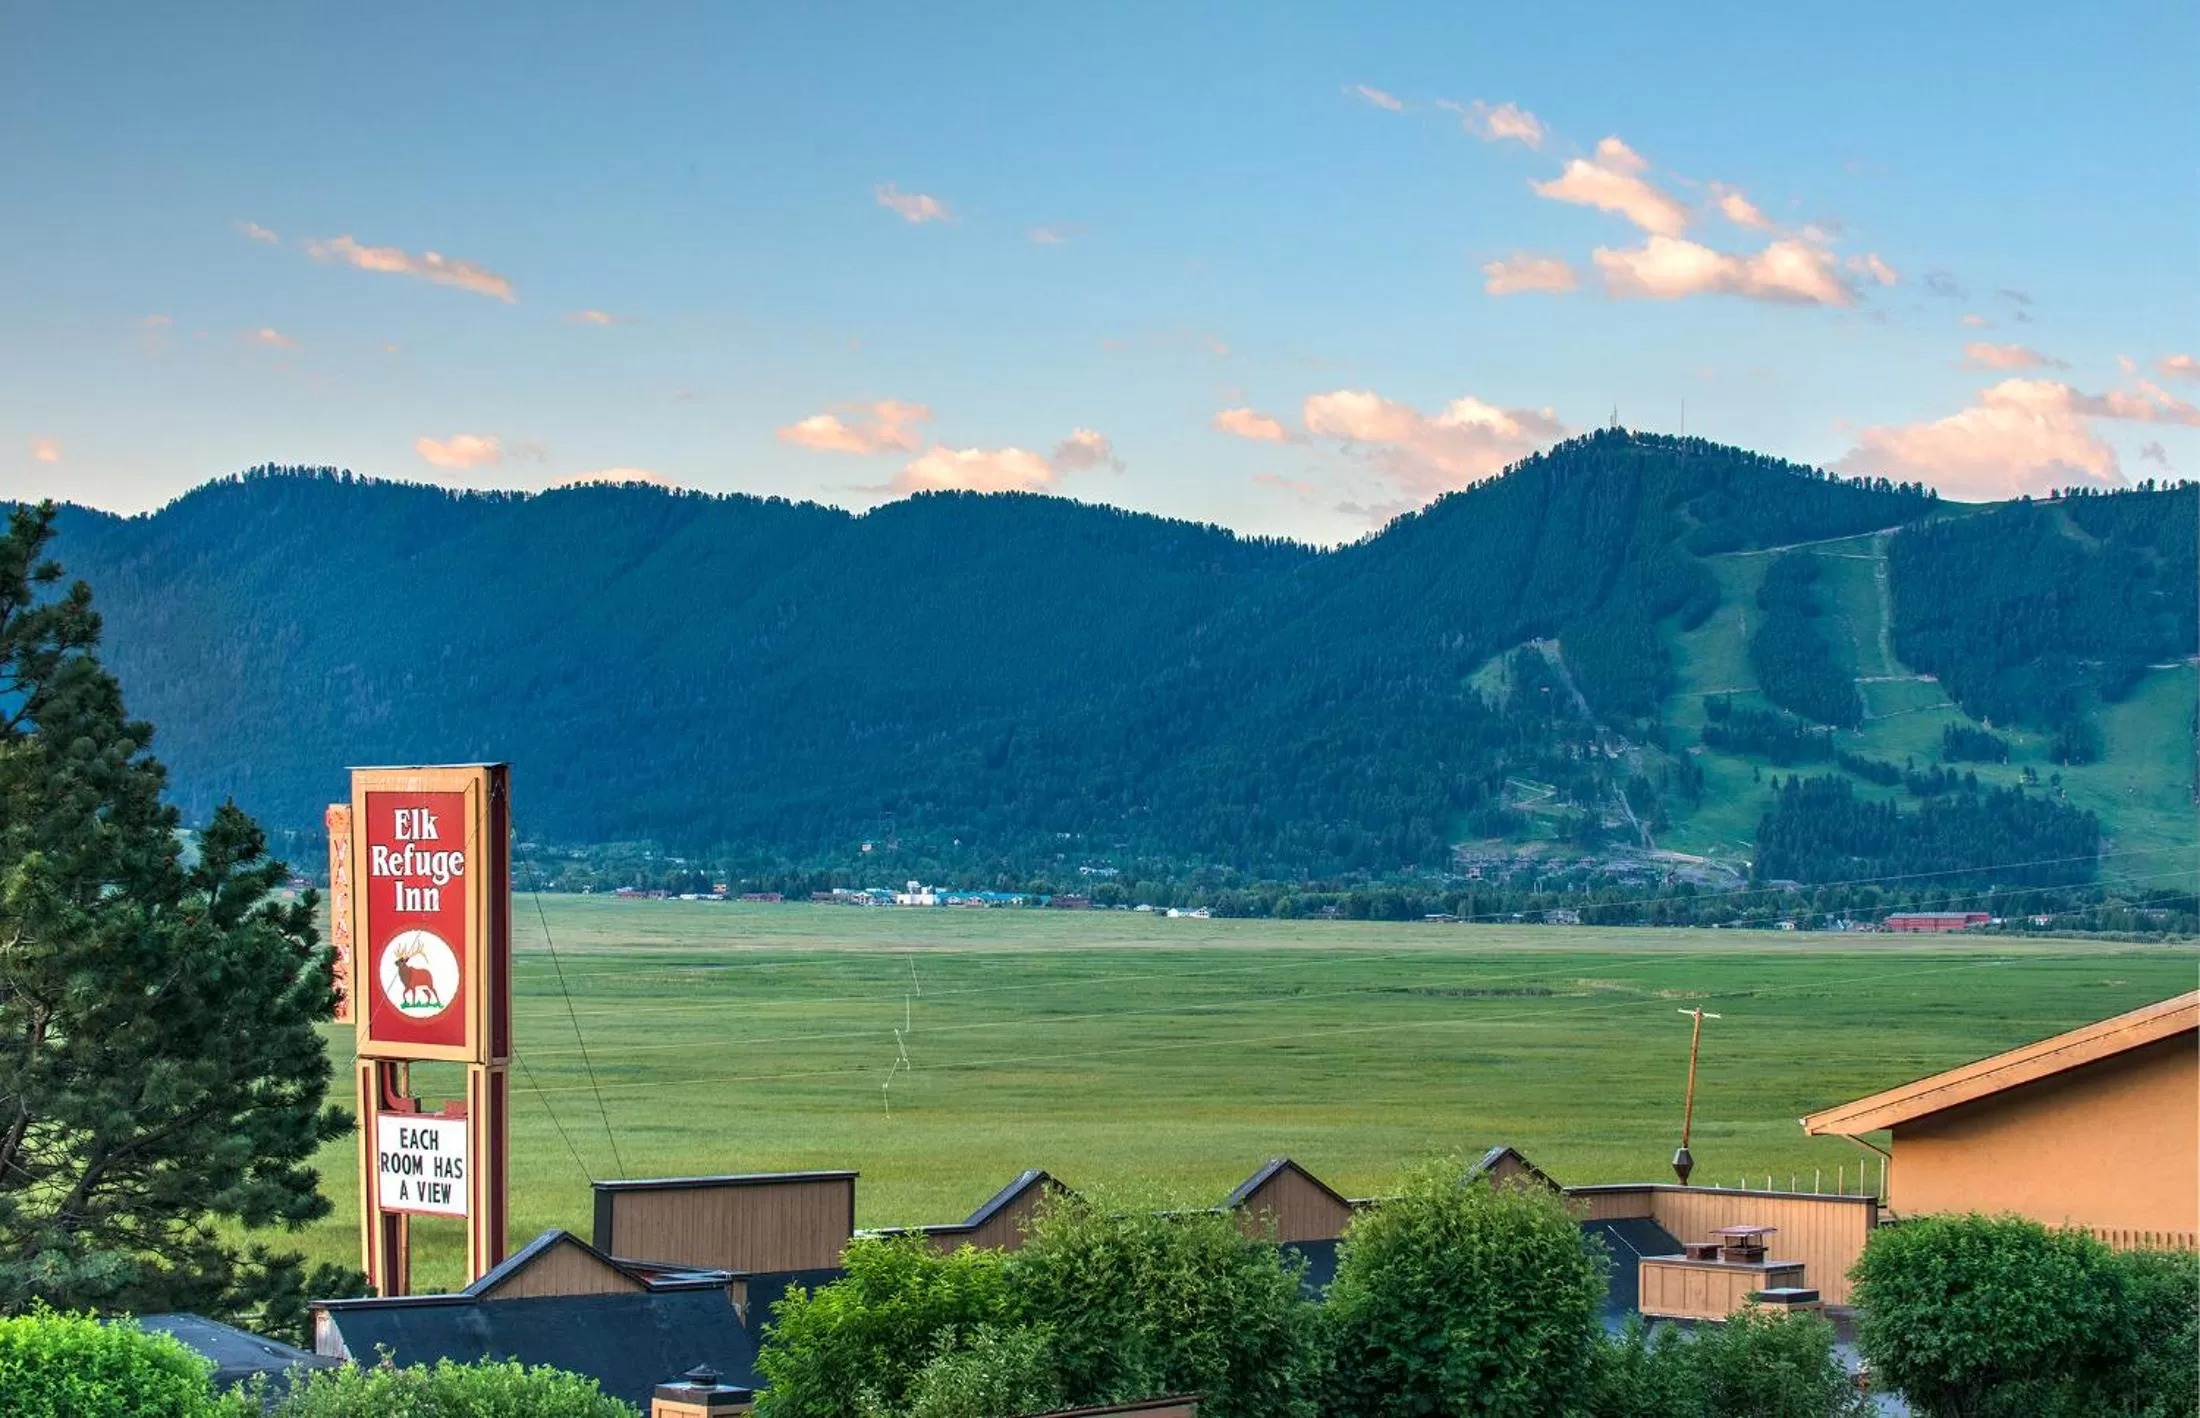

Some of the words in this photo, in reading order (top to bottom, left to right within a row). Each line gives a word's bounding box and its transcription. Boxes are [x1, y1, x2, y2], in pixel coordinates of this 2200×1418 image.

[394, 808, 439, 840] Elk
[371, 843, 464, 886] Refuge
[395, 881, 441, 912] Inn
[400, 1127, 439, 1151] EACH
[380, 1152, 423, 1176] ROOM
[434, 1156, 463, 1179] HAS
[399, 1179, 409, 1200] A
[417, 1181, 451, 1204] VIEW
